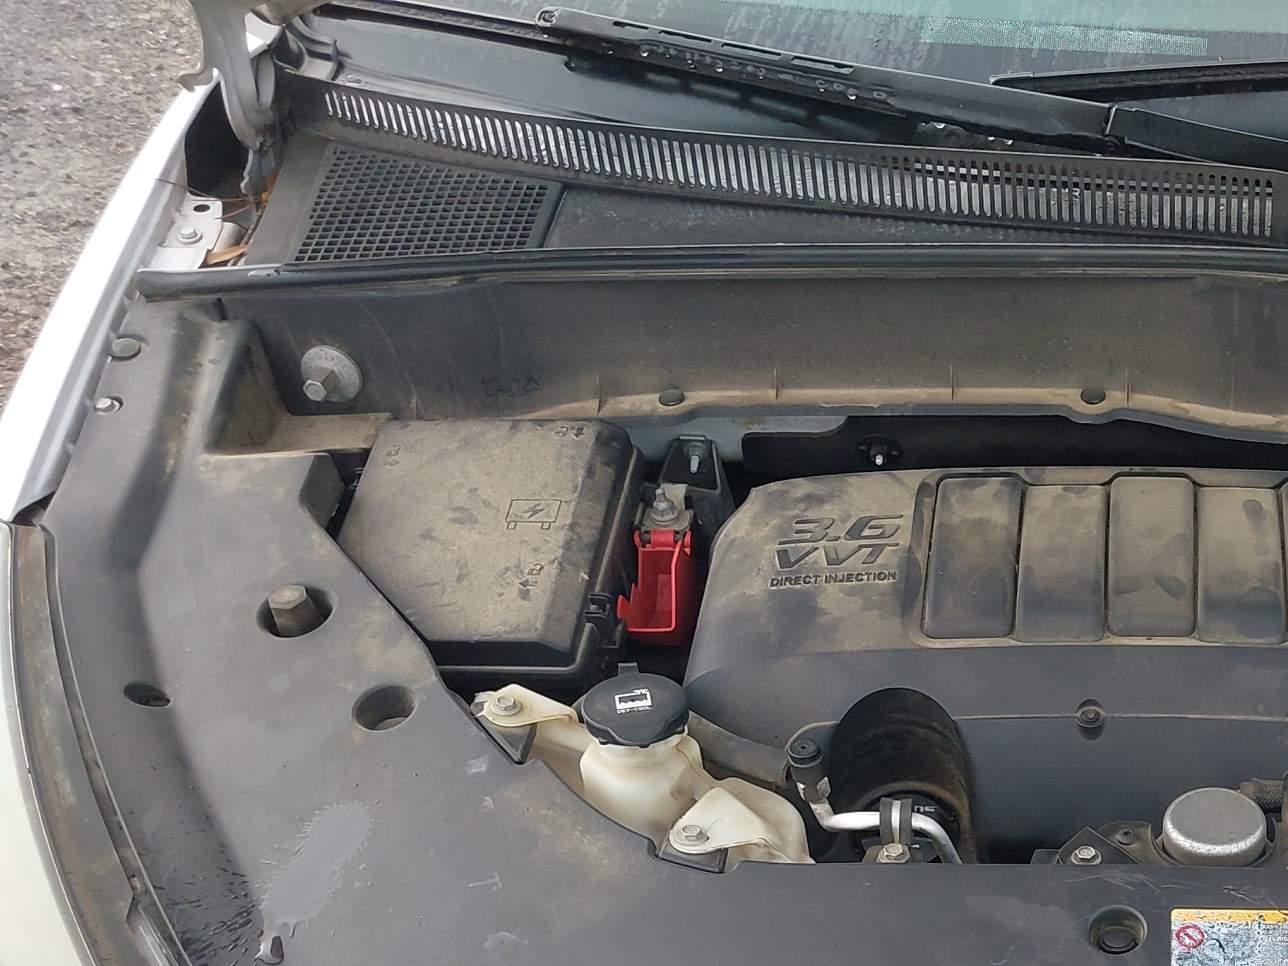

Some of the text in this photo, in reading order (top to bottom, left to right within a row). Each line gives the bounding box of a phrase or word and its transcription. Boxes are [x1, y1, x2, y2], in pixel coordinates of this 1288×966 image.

[778, 514, 904, 546] 3.6
[776, 543, 900, 570] VVT
[769, 570, 898, 589] DIRECT INJECTION
